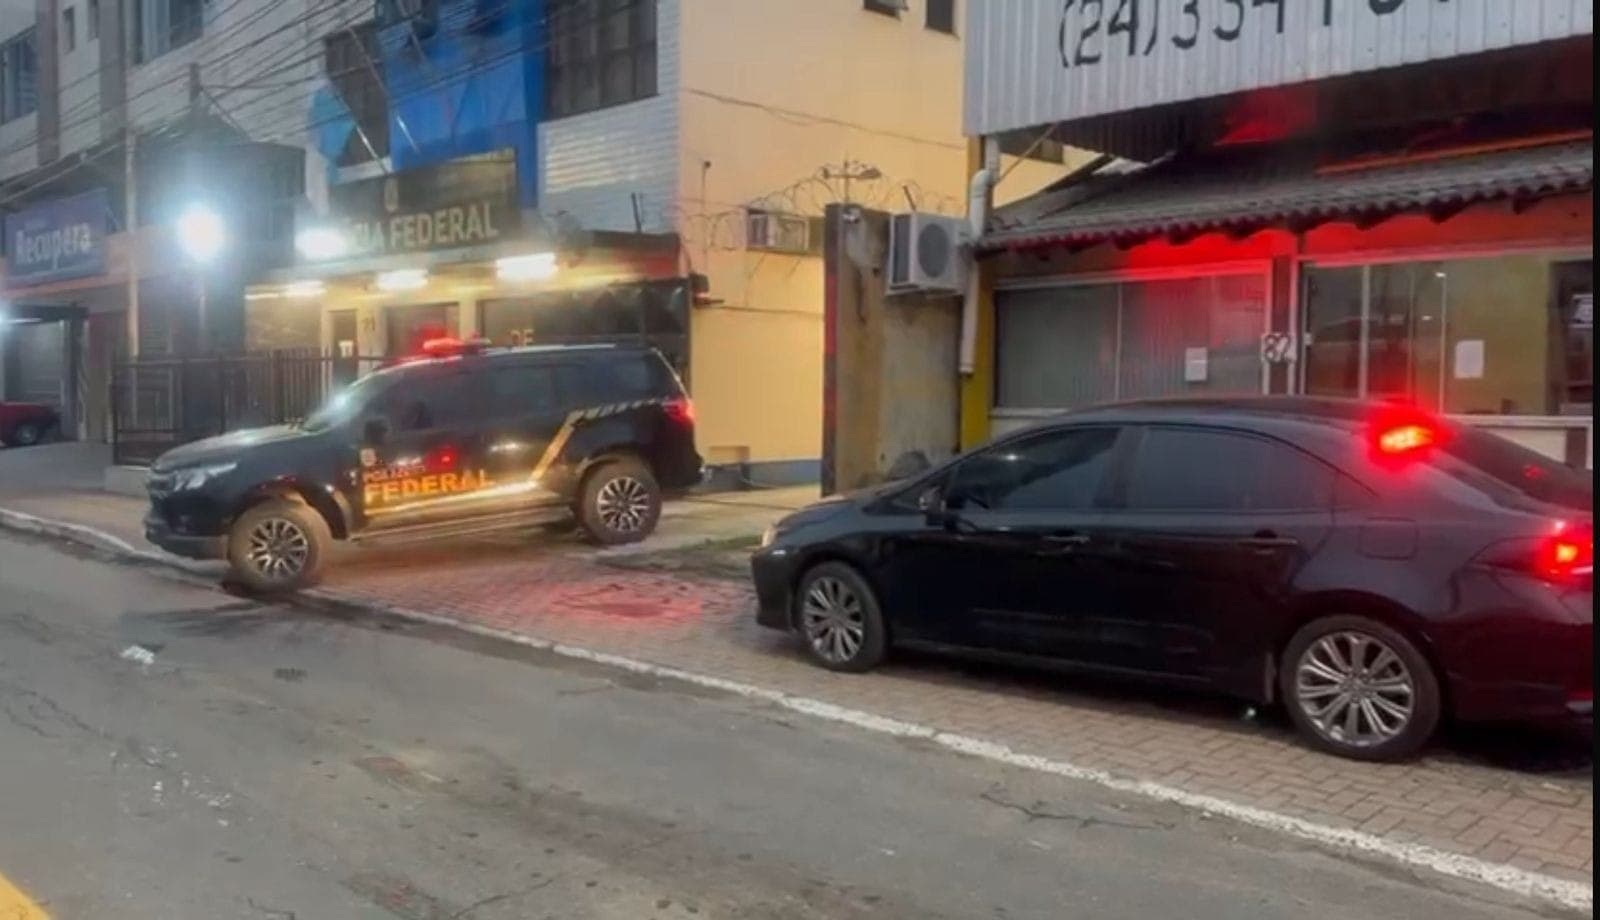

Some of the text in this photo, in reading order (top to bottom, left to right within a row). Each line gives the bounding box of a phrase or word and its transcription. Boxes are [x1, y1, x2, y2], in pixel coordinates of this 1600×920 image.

[16, 222, 91, 270] Recupera
[389, 202, 499, 249] FEDERAL
[364, 468, 497, 504] FEDERAL
